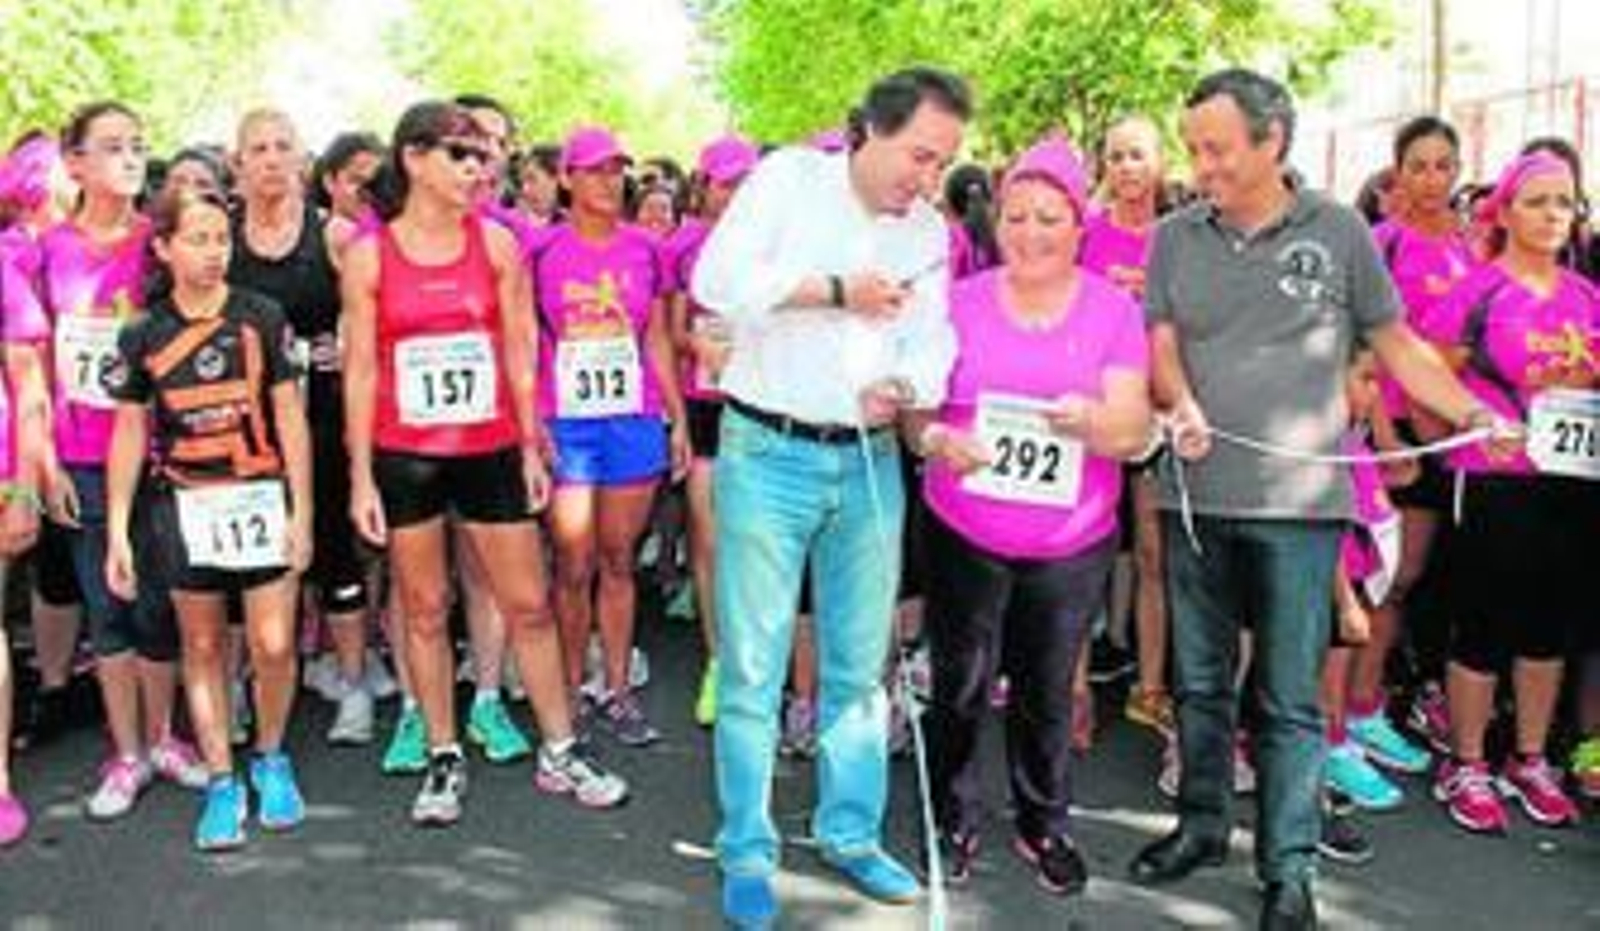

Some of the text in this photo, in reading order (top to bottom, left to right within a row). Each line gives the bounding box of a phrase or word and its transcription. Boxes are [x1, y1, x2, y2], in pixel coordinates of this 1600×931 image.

[422, 369, 474, 409] 157
[576, 369, 625, 400] 312
[991, 435, 1060, 483] 292
[211, 513, 271, 554] 112
